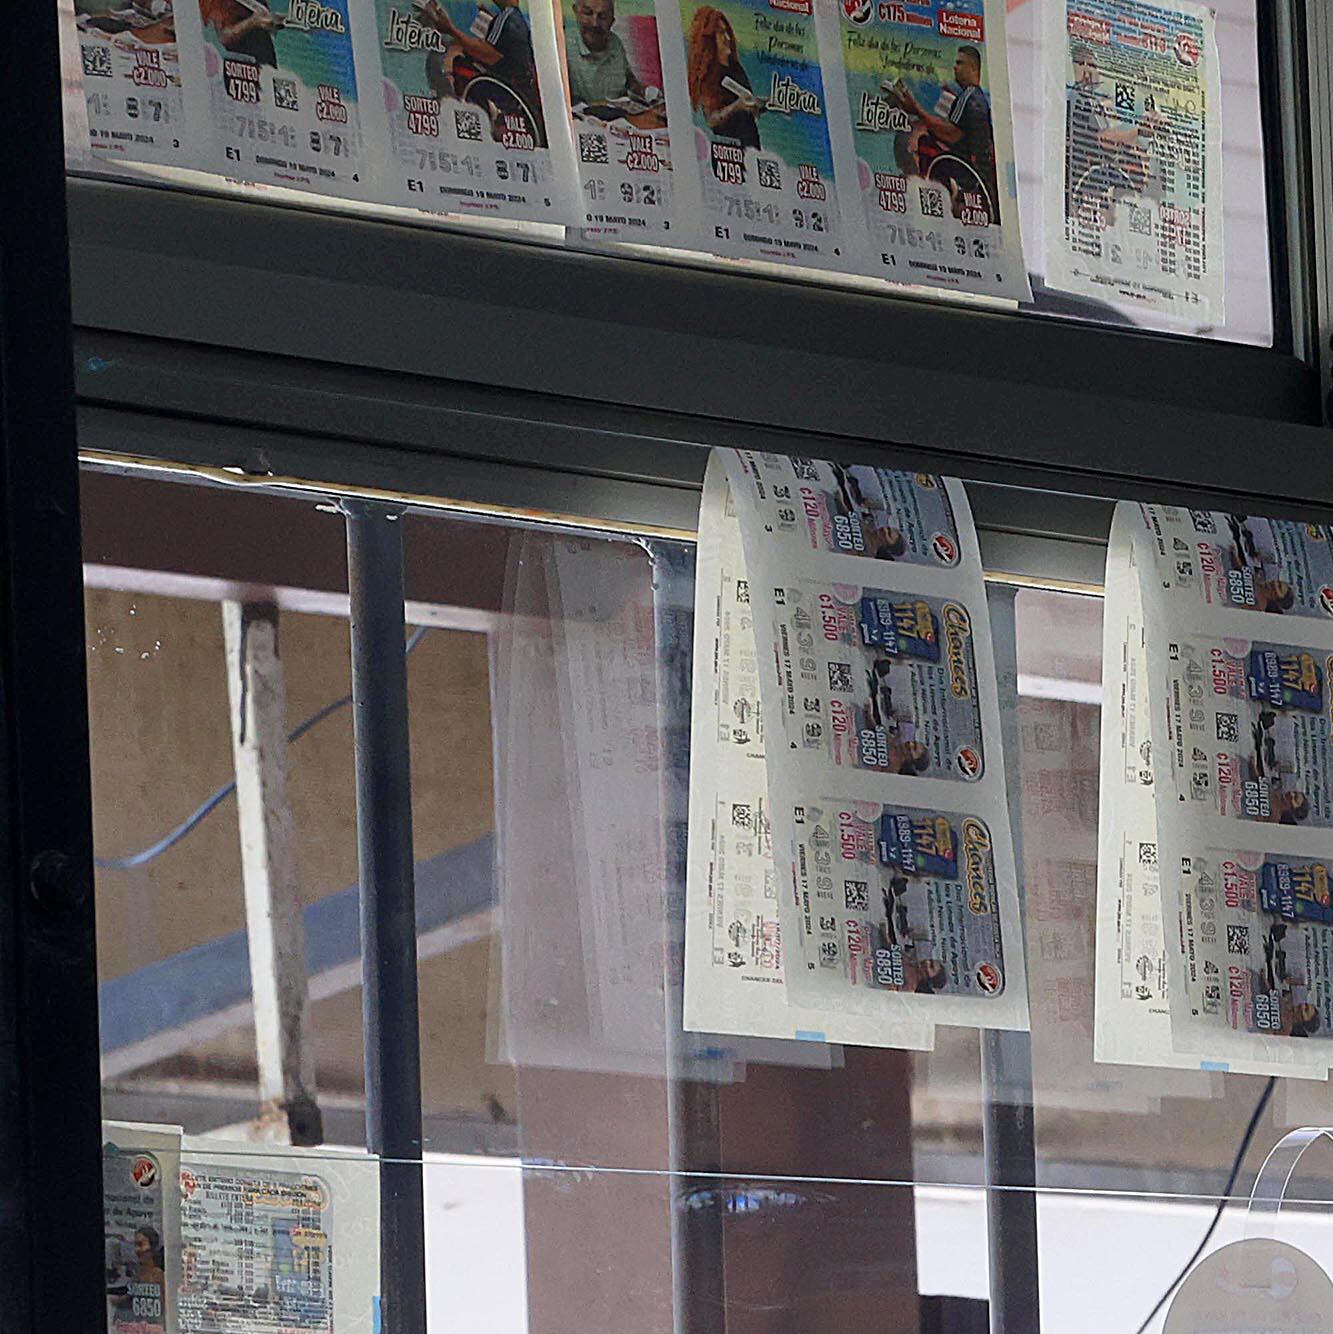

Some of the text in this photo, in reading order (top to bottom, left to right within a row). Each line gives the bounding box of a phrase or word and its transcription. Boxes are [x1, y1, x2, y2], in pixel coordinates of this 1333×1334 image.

[939, 21, 982, 39] Nacional
[135, 50, 160, 68] VALE
[224, 60, 259, 81] SORTEO
[228, 80, 260, 103] 4799
[318, 85, 341, 104] VALE
[404, 96, 440, 116] SORTEO
[407, 113, 440, 137] 4799
[503, 114, 526, 134] VALE
[226, 147, 241, 161] E1
[629, 138, 655, 153] VALE
[711, 142, 744, 163] SORTEO
[715, 161, 745, 185] 4799
[800, 163, 819, 181] VALE
[407, 179, 424, 193] E1
[874, 173, 907, 193] SORTEO
[878, 191, 906, 214] 4799
[964, 192, 982, 210] VALE
[714, 225, 730, 240] E1
[881, 253, 897, 266] E1
[833, 514, 852, 551] 6850
[774, 587, 785, 606] E1
[894, 602, 921, 640] 1147
[1168, 642, 1179, 662] E1
[860, 729, 878, 767] 6850
[875, 724, 889, 767] SORTEO
[1244, 780, 1260, 817] 6850
[794, 806, 805, 825] E1
[912, 816, 937, 856] 1147
[1181, 856, 1192, 876] E1
[1290, 865, 1314, 901] 1147
[875, 949, 893, 985] 6850
[889, 943, 905, 987] SORTEO
[1254, 994, 1271, 1030] 6850
[1268, 989, 1282, 1031] SORTEO
[132, 1295, 162, 1318] 6850
